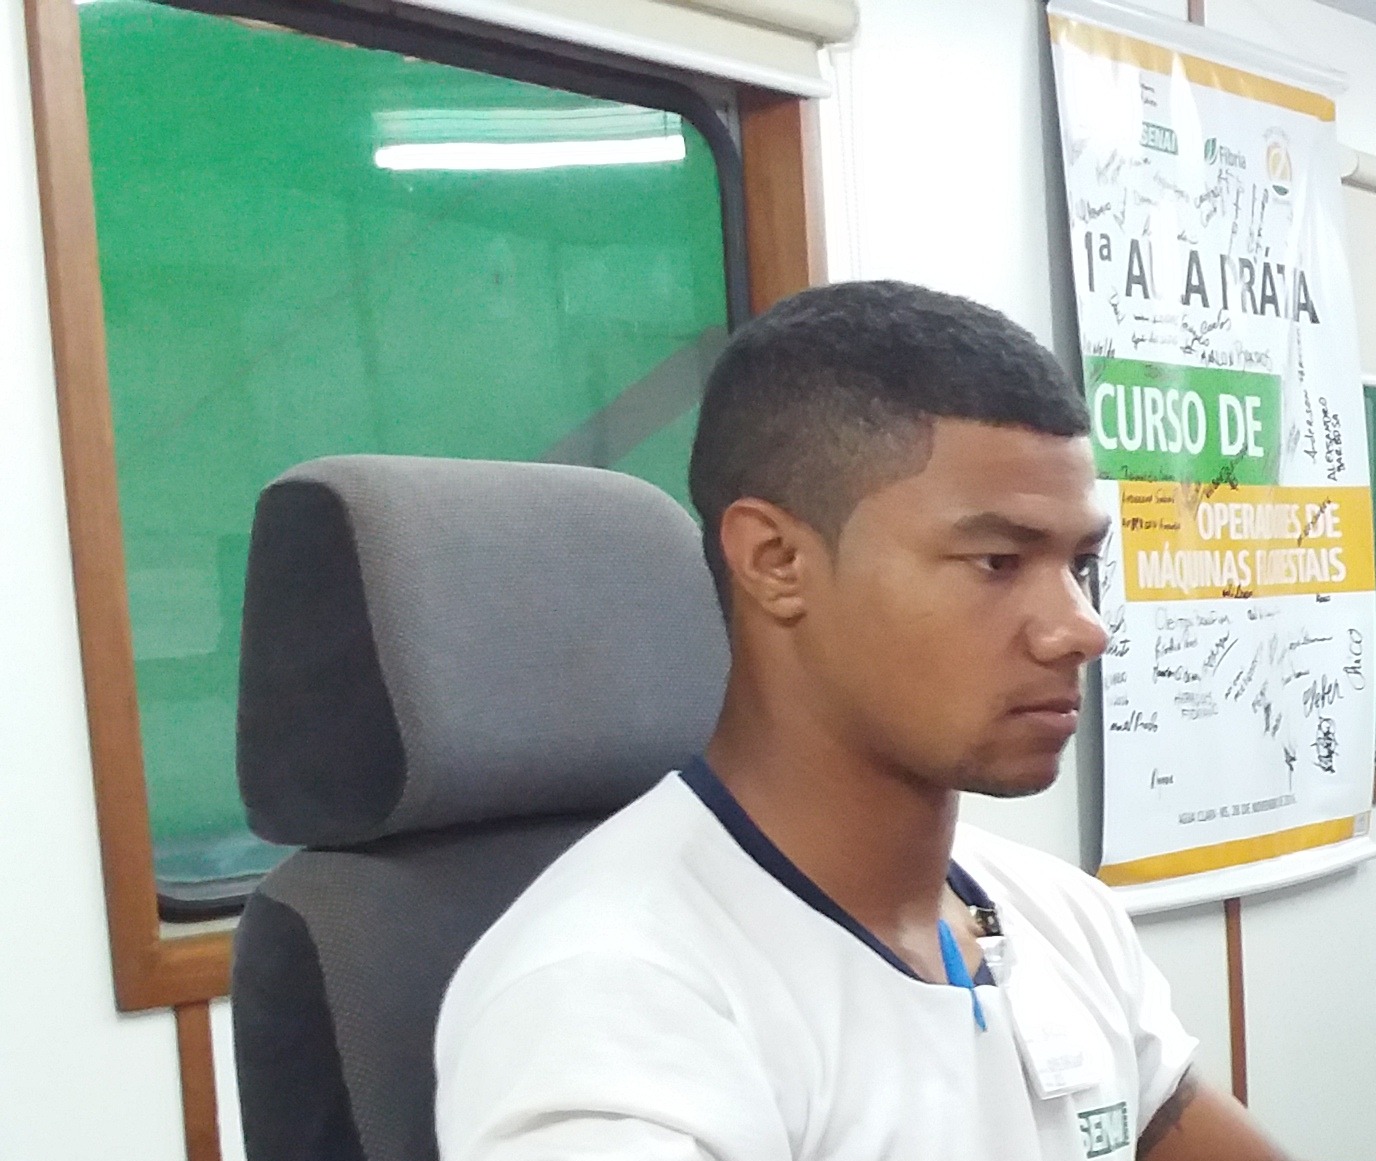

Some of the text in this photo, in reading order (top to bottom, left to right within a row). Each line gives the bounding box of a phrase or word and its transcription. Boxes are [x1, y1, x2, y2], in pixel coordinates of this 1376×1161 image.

[1125, 238, 1211, 308] AA
[1094, 382, 1265, 458] CURSO DE
[1305, 502, 1342, 539] DE
[1138, 541, 1252, 595] MÁQUINAS
